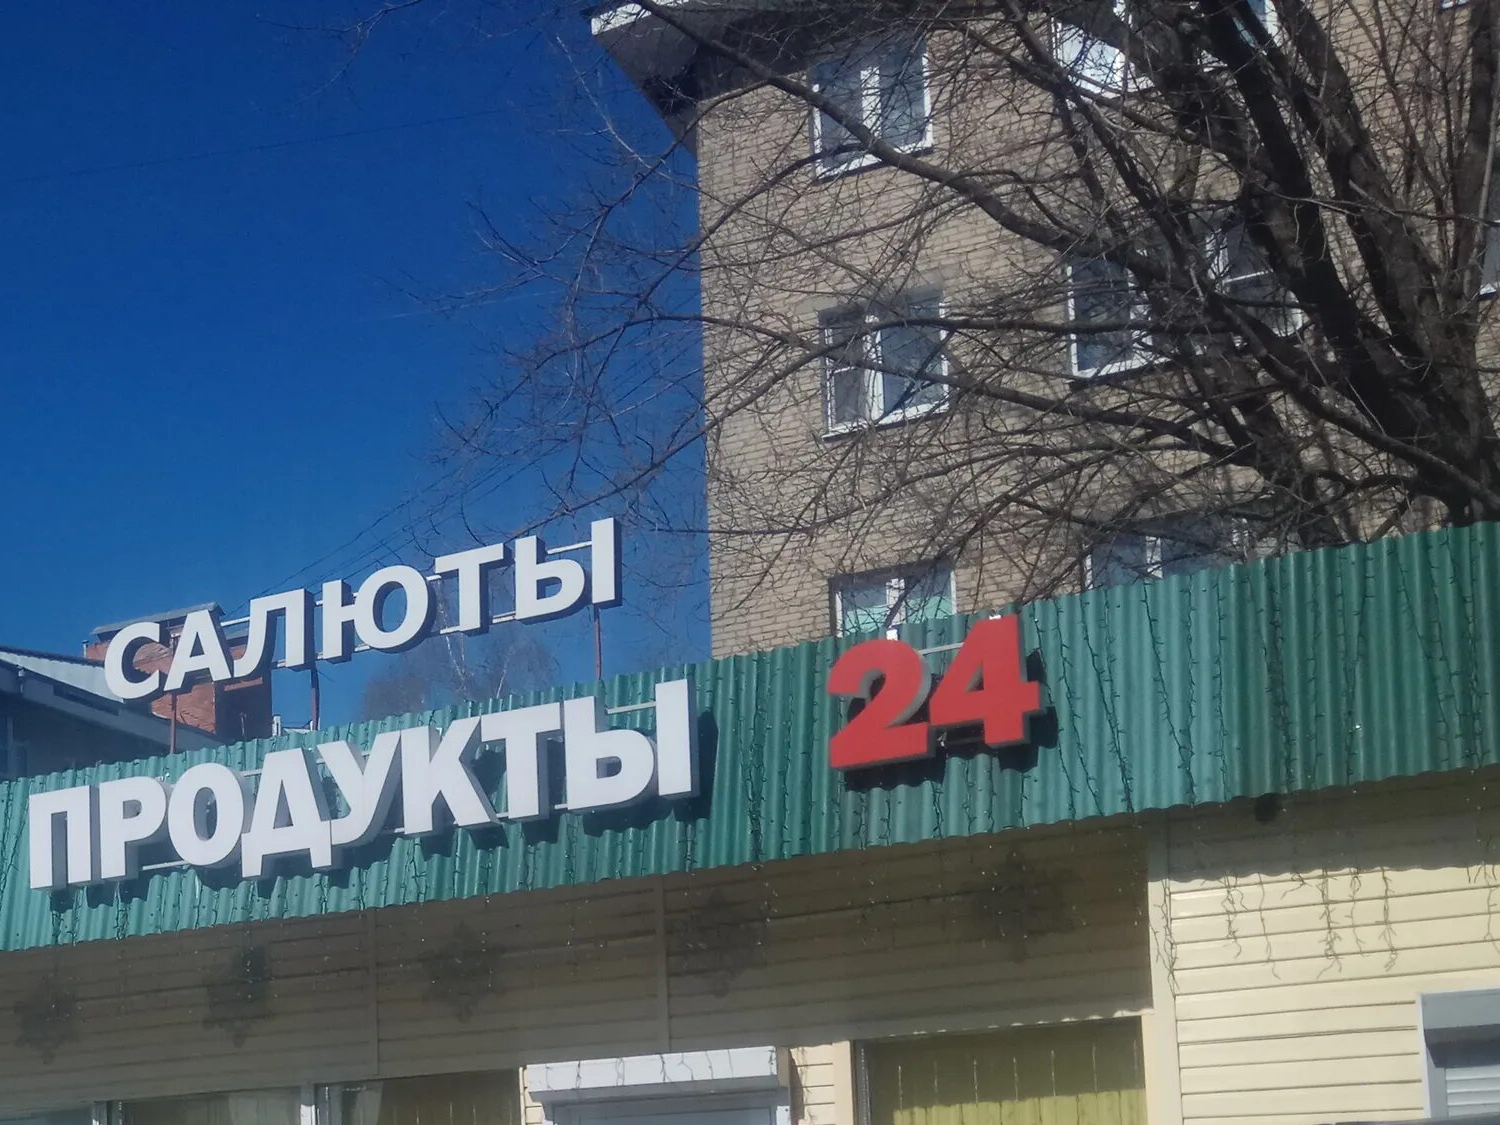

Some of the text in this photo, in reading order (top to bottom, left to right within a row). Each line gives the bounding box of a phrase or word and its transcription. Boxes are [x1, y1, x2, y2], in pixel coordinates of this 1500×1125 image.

[103, 516, 617, 701] САЛЮТЫ
[27, 612, 1041, 890] ПРОДУКТЫ 24
